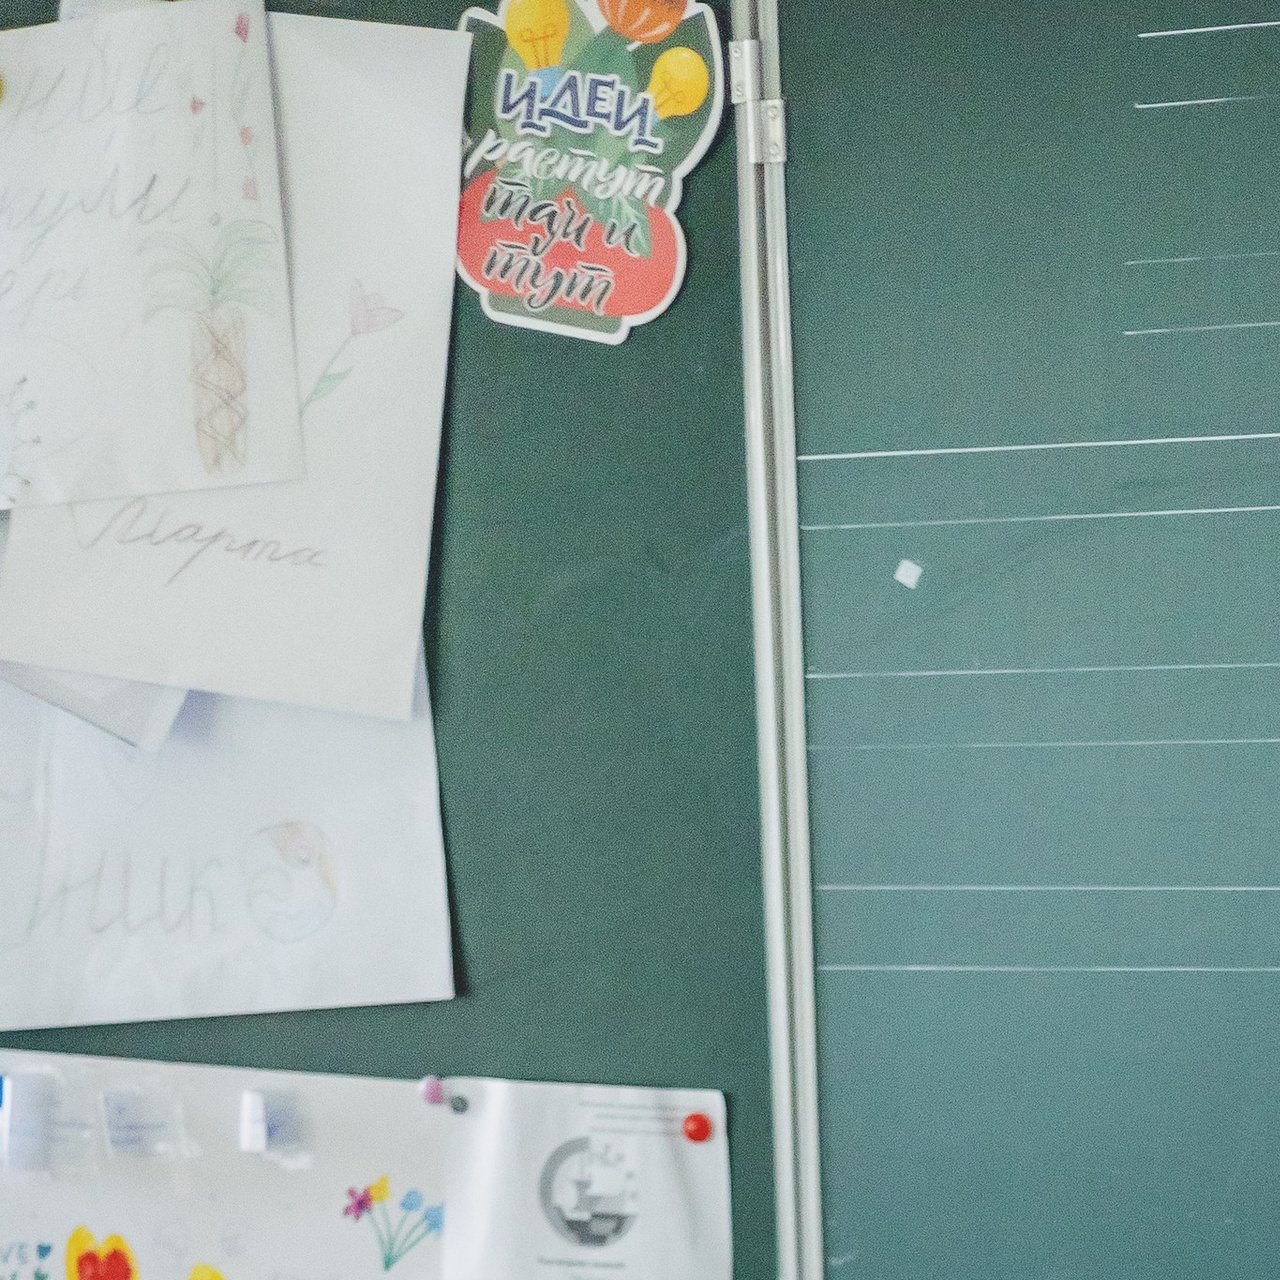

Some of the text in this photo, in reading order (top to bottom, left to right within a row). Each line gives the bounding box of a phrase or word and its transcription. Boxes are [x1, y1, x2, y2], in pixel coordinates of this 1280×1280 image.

[499, 70, 662, 151] ИДЕИ
[463, 129, 667, 207] растут
[481, 239, 616, 315] тут
